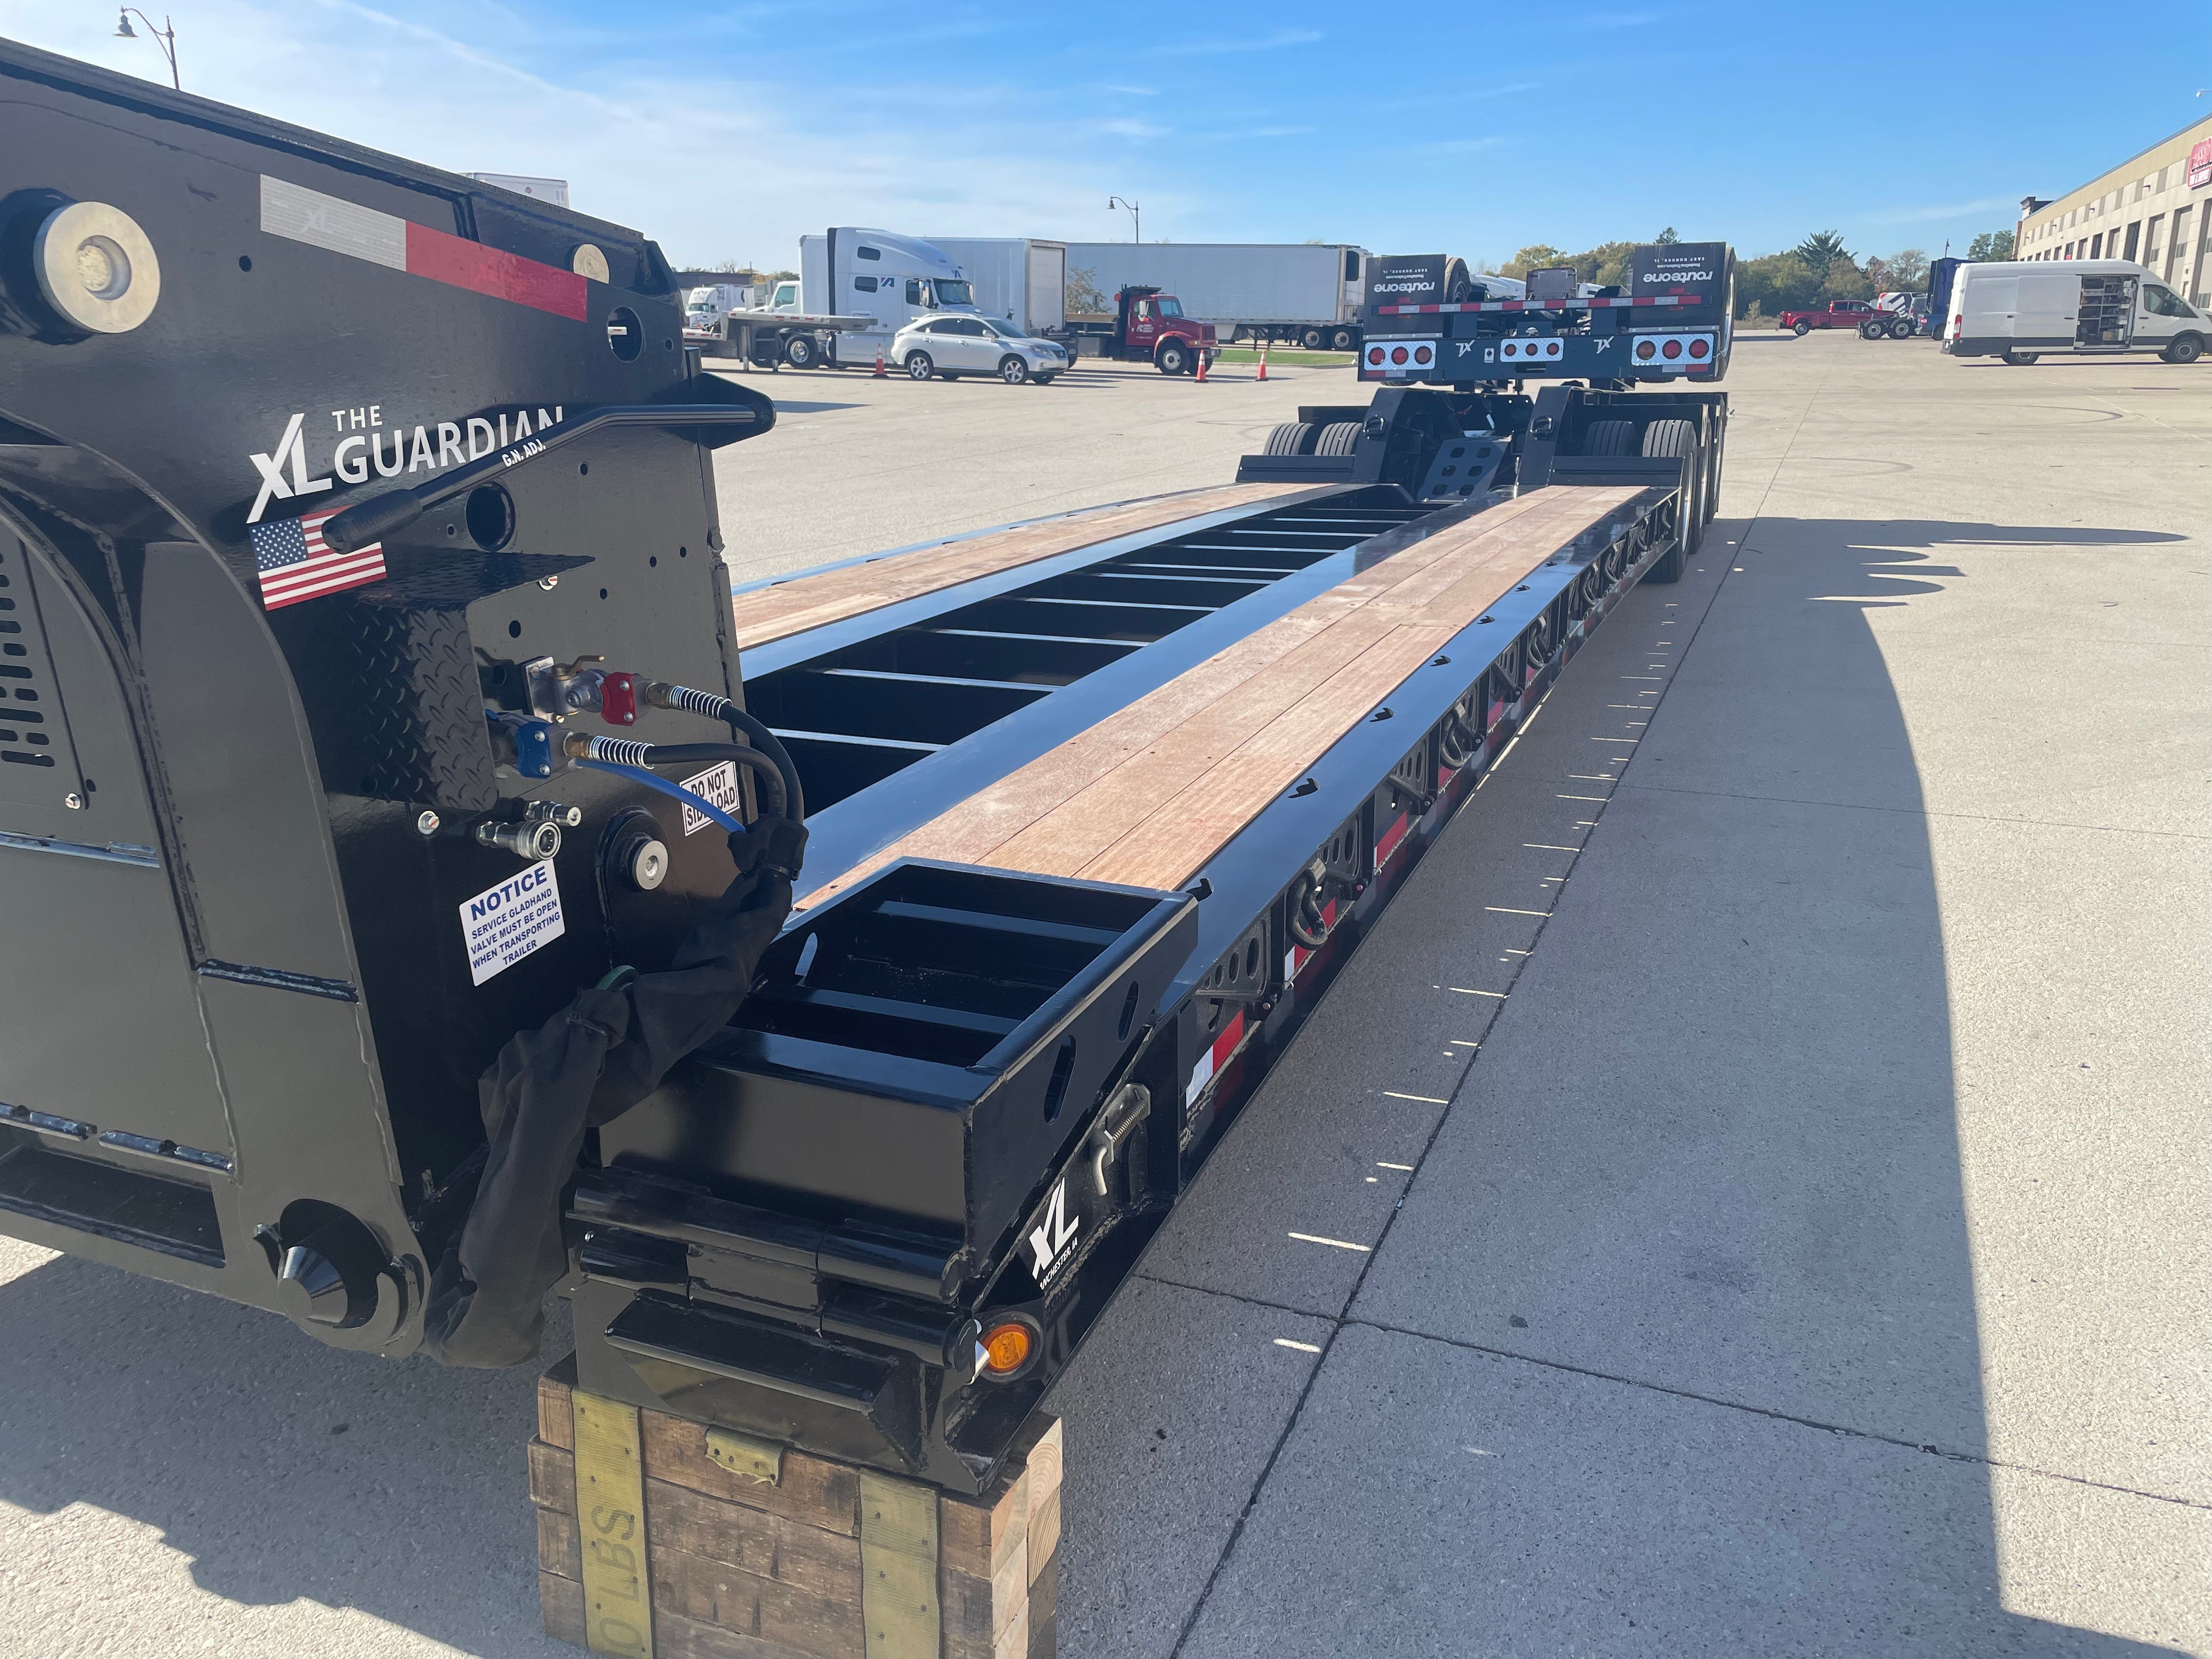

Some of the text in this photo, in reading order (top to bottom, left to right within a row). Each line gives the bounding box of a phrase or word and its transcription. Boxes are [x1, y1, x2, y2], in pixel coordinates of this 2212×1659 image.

[1374, 281, 1435, 293] routeone
[1643, 271, 1713, 283] routeone
[331, 405, 382, 432] THE
[246, 413, 332, 523] XL
[334, 406, 563, 484] GUARDIAN
[502, 438, 546, 467] G.N. ADJ.
[691, 769, 726, 797] DO NOT
[471, 866, 547, 921] NOTICE
[472, 888, 552, 940] SERVICE GLADHAND
[471, 899, 557, 955] VALVE MUST BE OPEN
[472, 912, 560, 969] WHEN TRANSPORTING
[503, 939, 537, 966] TRAILER
[1029, 1177, 1079, 1280] XL
[1072, 1237, 1078, 1251] IA
[591, 1505, 640, 1602] LBS
